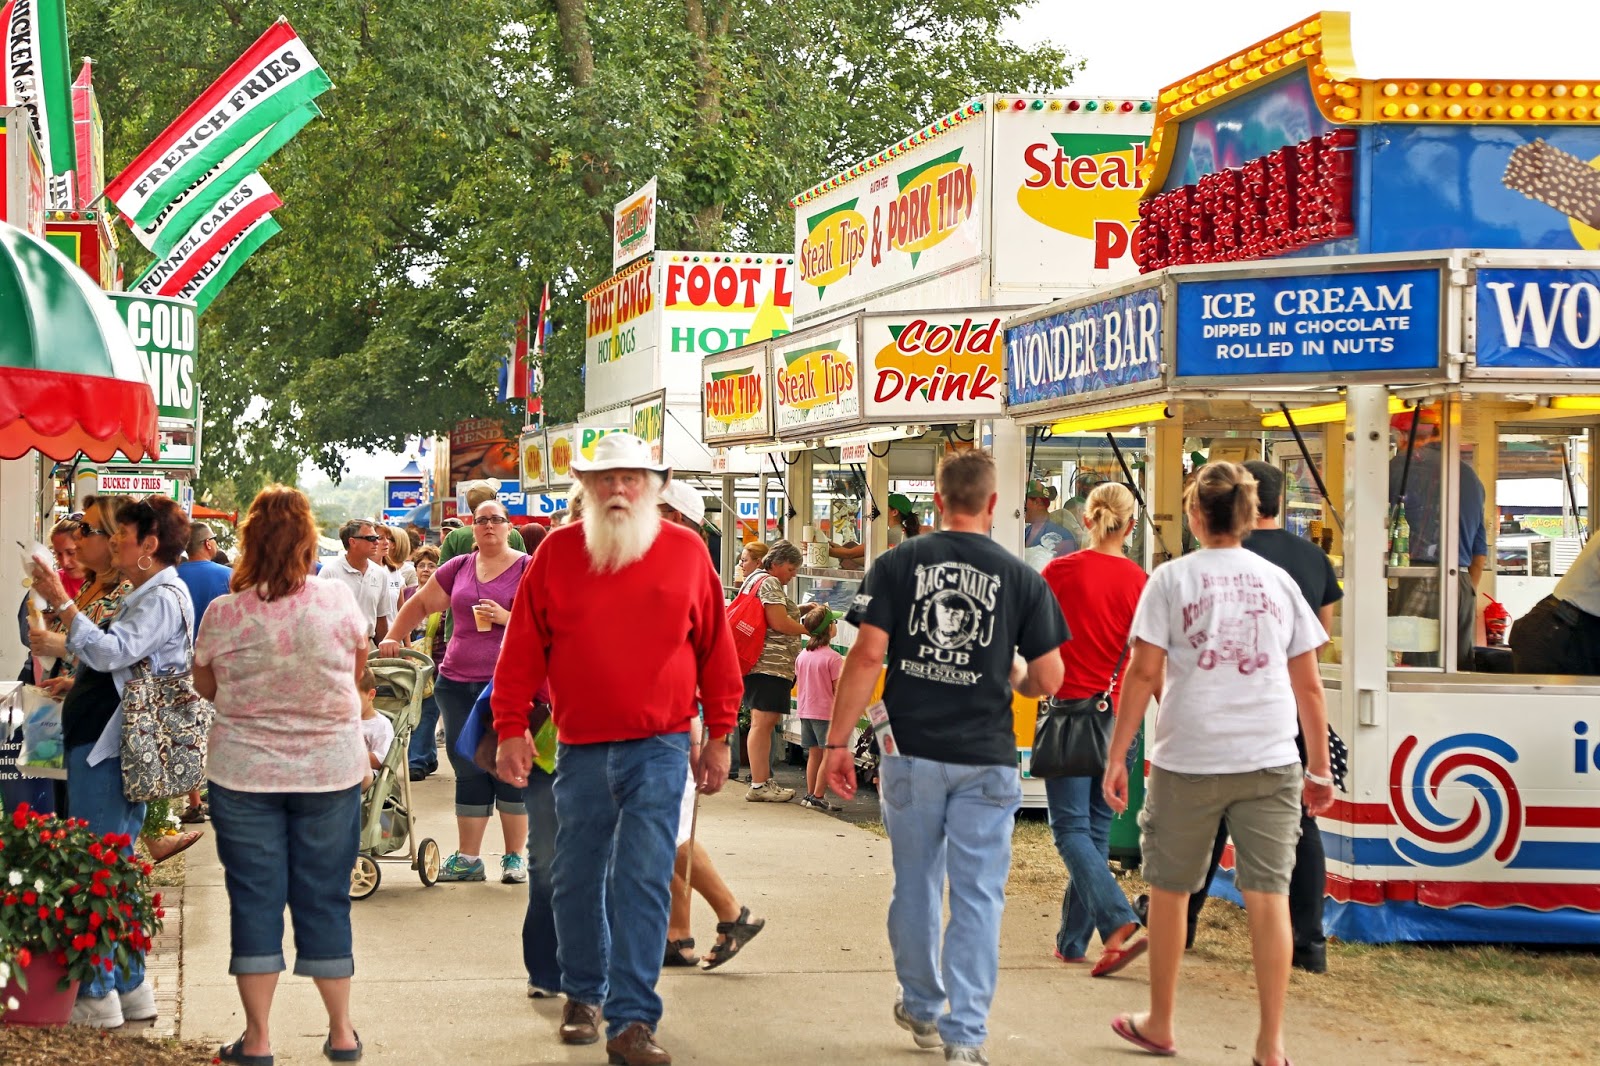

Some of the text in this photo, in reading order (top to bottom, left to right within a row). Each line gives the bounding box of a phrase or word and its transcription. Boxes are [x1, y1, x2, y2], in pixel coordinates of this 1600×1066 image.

[132, 106, 231, 199] FRENCH
[228, 50, 301, 113] FRIES
[138, 184, 253, 295] FUNNEL CAKES
[800, 162, 974, 282] Steak Tips & PORK TIPS
[589, 265, 652, 338] FOOT LONGS
[665, 264, 762, 308] FOOT
[1201, 284, 1413, 320] ICE CREAM
[127, 301, 194, 352] COLD
[598, 326, 636, 364] HOT DOGS
[896, 317, 1000, 354] Cold
[1009, 301, 1158, 391] WONDER BAR
[1203, 316, 1410, 339] DIPPED IN CHOCOLATE
[1215, 335, 1395, 360] ROLLED IN NUTS
[706, 372, 762, 418] PORK TIPS
[777, 351, 853, 406] Steak Tips
[873, 365, 999, 404] Drink
[813, 402, 834, 420] POTATOES
[840, 396, 858, 415] ONIONS
[102, 477, 131, 489] BUCKET
[141, 478, 161, 490] FRIES
[391, 491, 420, 500] PEPSI
[914, 566, 999, 612] BAG of NAILS
[900, 659, 983, 684] FISH STORY
[918, 645, 970, 666] PUB
